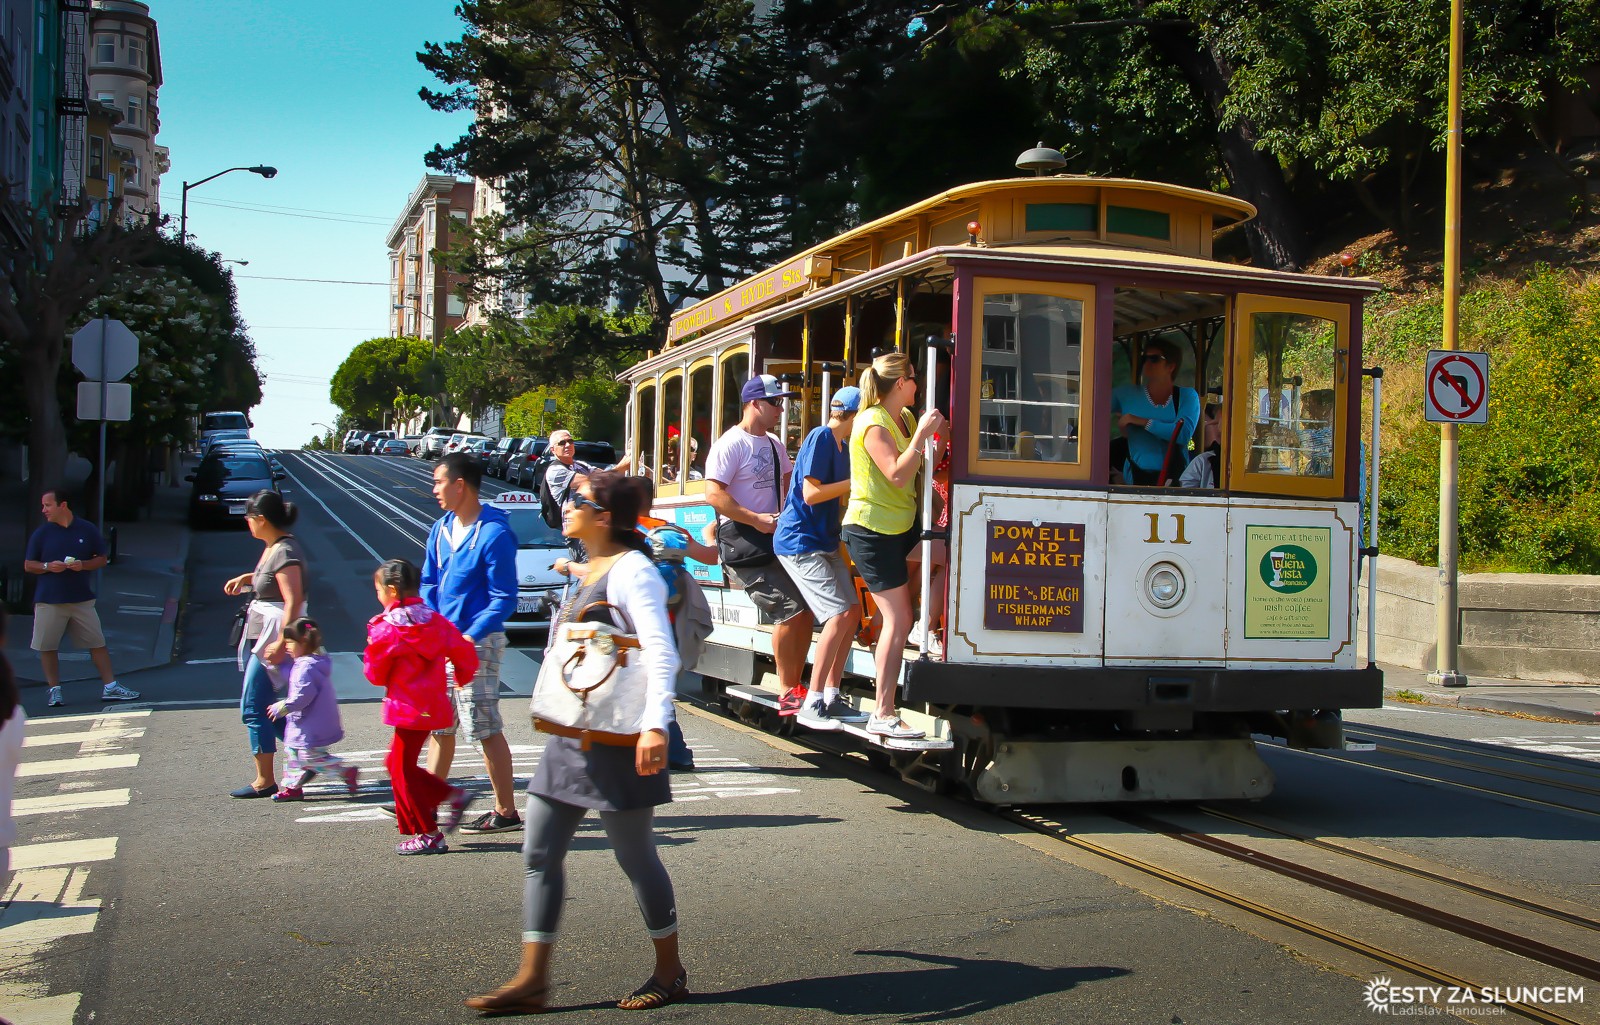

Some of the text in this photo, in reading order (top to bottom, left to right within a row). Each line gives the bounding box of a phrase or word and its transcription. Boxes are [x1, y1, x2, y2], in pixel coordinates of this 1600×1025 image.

[675, 306, 717, 336] POWELL
[723, 297, 733, 314] &
[741, 277, 776, 308] HYDE
[501, 494, 532, 502] TAXI
[993, 526, 1080, 542] POWELL
[1143, 513, 1192, 545] 11
[1016, 541, 1060, 552] AND
[991, 551, 1082, 567] MARKET
[1284, 552, 1297, 560] the
[990, 584, 1079, 602] HYDE AND BEACH
[997, 603, 1071, 616] FISHERMANS
[1015, 615, 1053, 626] WHARF
